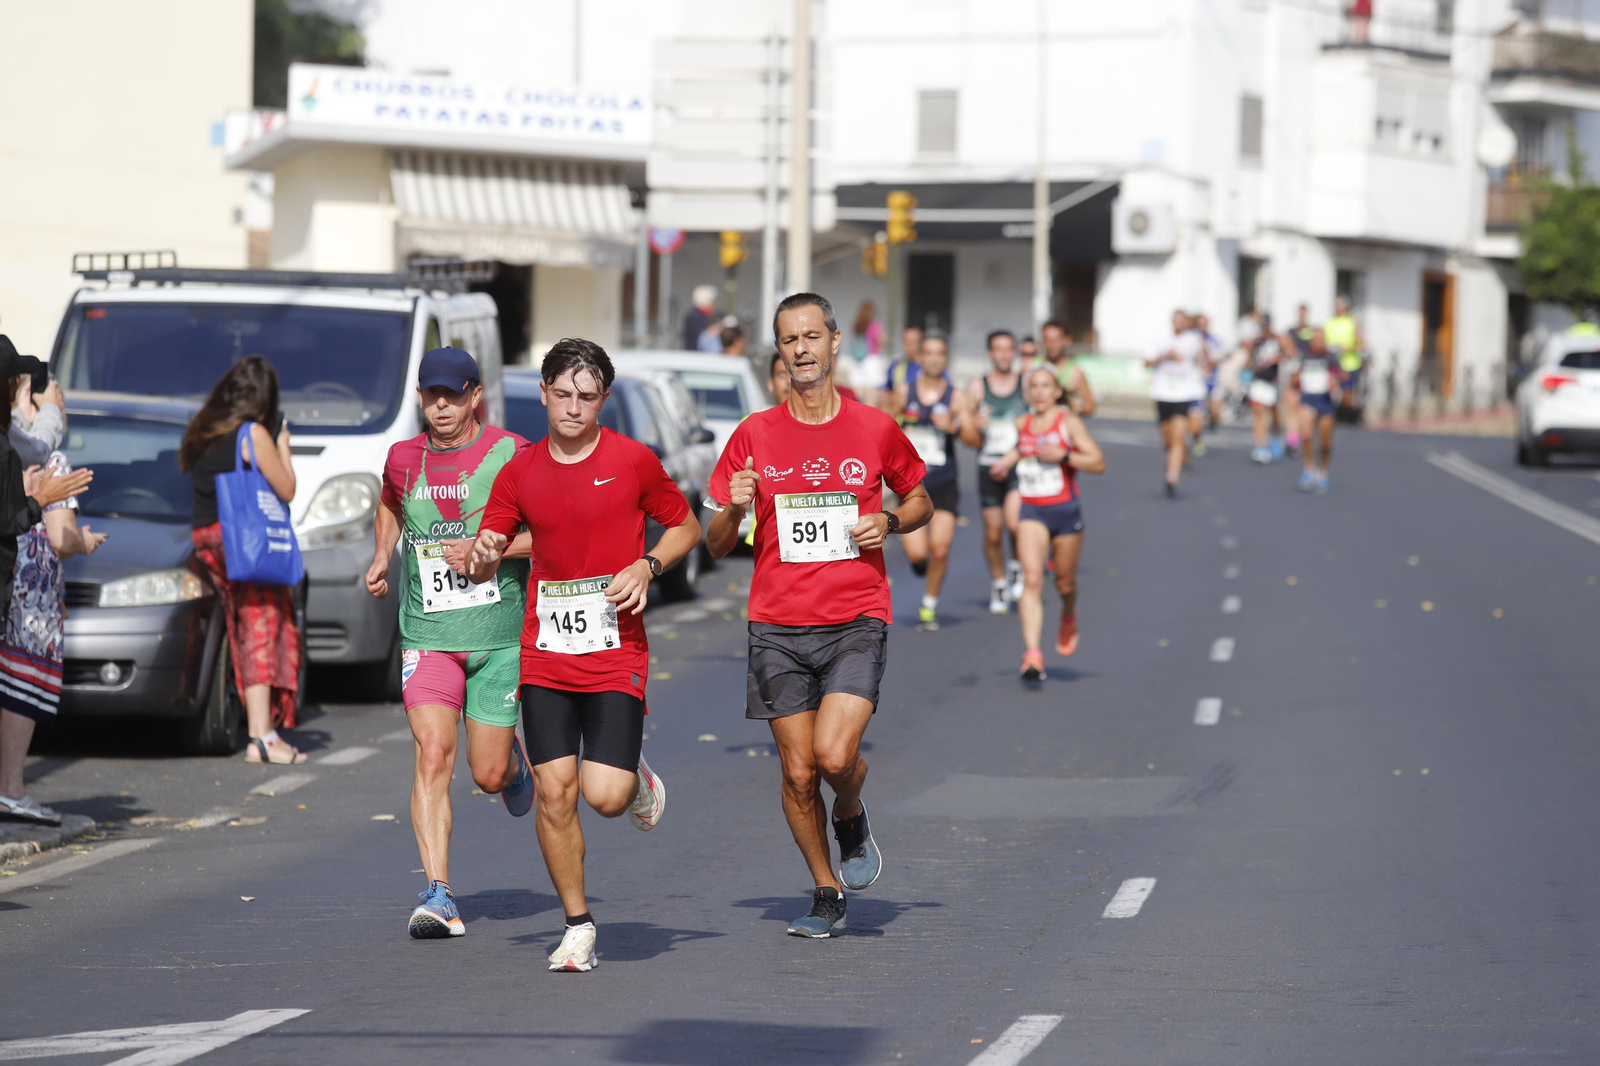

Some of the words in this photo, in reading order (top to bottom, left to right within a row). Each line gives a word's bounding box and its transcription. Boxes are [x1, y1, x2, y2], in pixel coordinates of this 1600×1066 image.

[333, 76, 477, 102] CHURROS
[374, 104, 510, 127] PATATAS
[521, 115, 625, 134] FRITAS
[415, 484, 470, 500] ANTONIO
[781, 498, 790, 507] 34
[791, 496, 817, 507] VUELTA
[818, 496, 825, 506] A
[825, 494, 852, 506] HUELVA
[792, 520, 828, 543] 591
[428, 546, 451, 557] VUELT
[433, 569, 469, 593] 515
[547, 585, 571, 595] VUELTA
[572, 584, 578, 595] A
[580, 581, 605, 593] HUELV
[550, 610, 587, 634] 145
